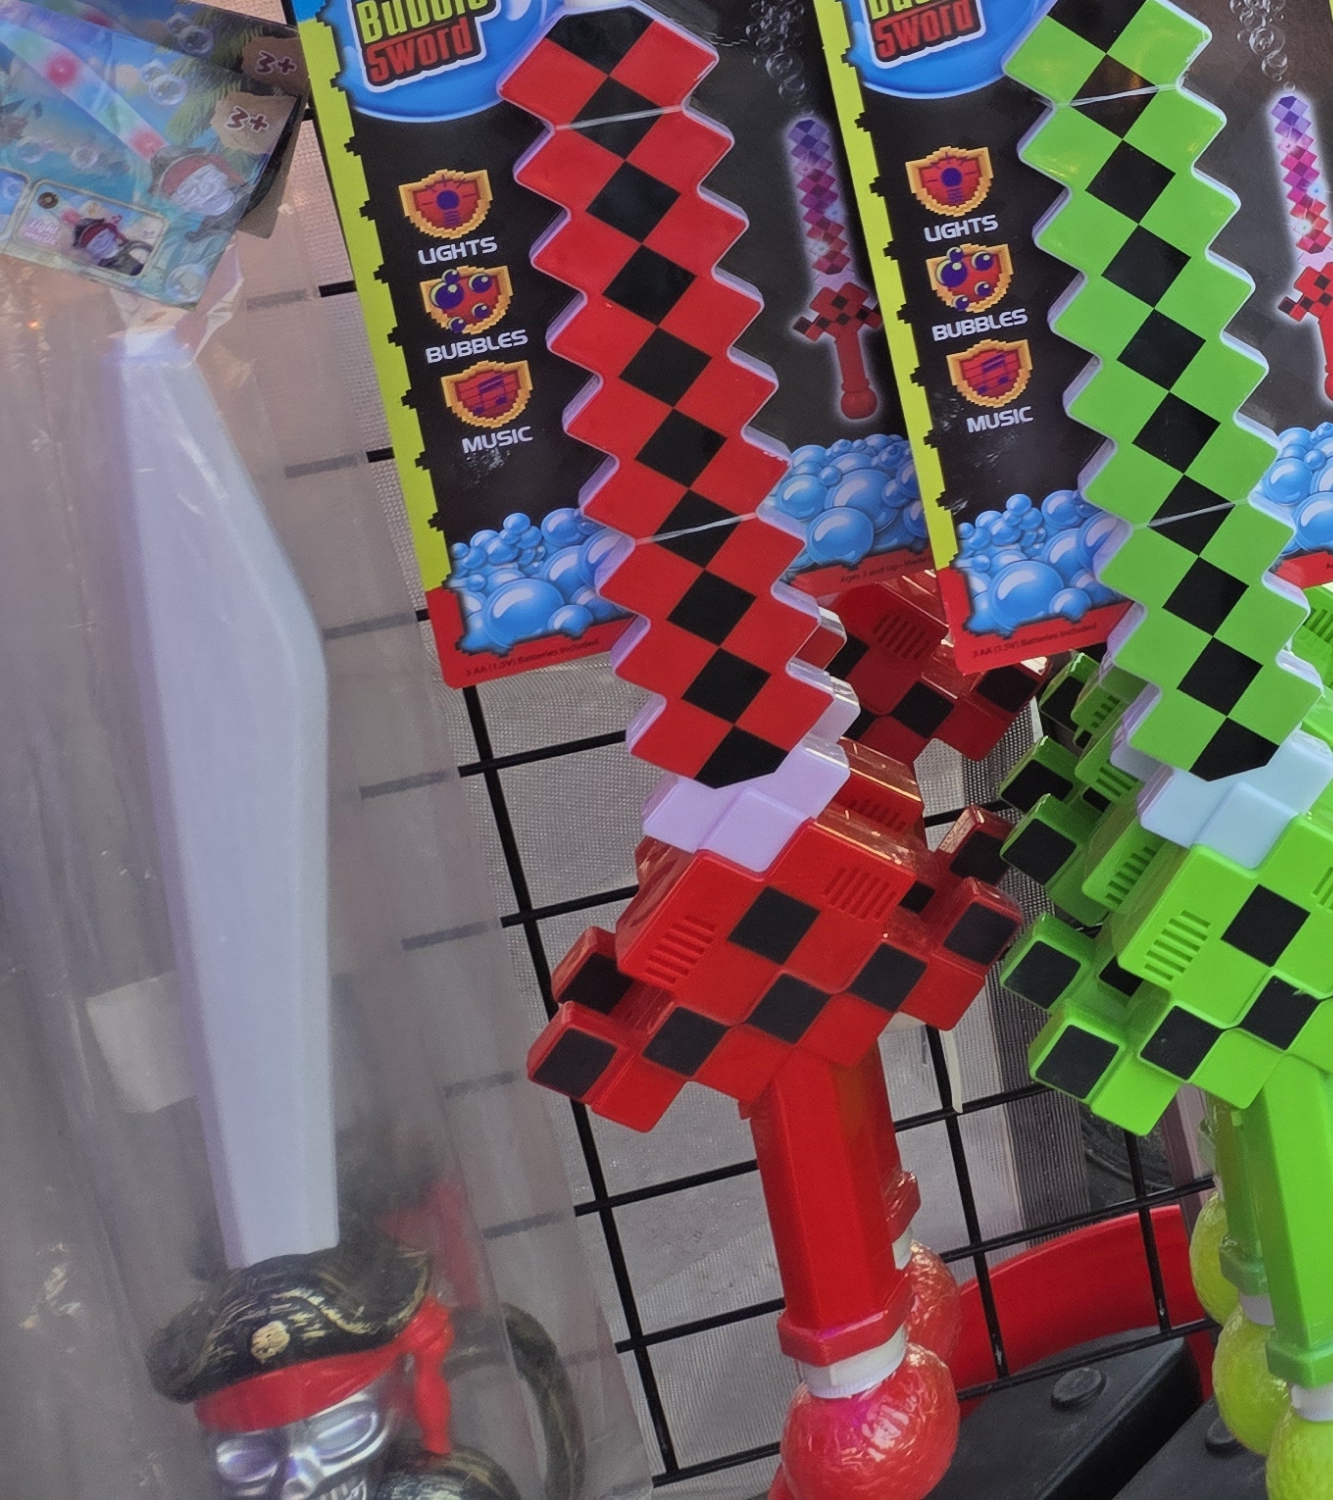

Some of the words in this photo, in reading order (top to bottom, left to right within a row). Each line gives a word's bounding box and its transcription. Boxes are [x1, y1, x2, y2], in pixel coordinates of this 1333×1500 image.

[257, 50, 297, 74] 3+
[366, 16, 473, 83] Sword
[225, 105, 269, 132] 3+
[924, 214, 999, 244] LIGHTS
[417, 236, 498, 266] LIGHTS
[932, 308, 1029, 342] BUBBLES
[425, 328, 529, 365] BUBBLES
[966, 406, 1034, 434] MUSIC
[461, 424, 534, 454] MUSIC
